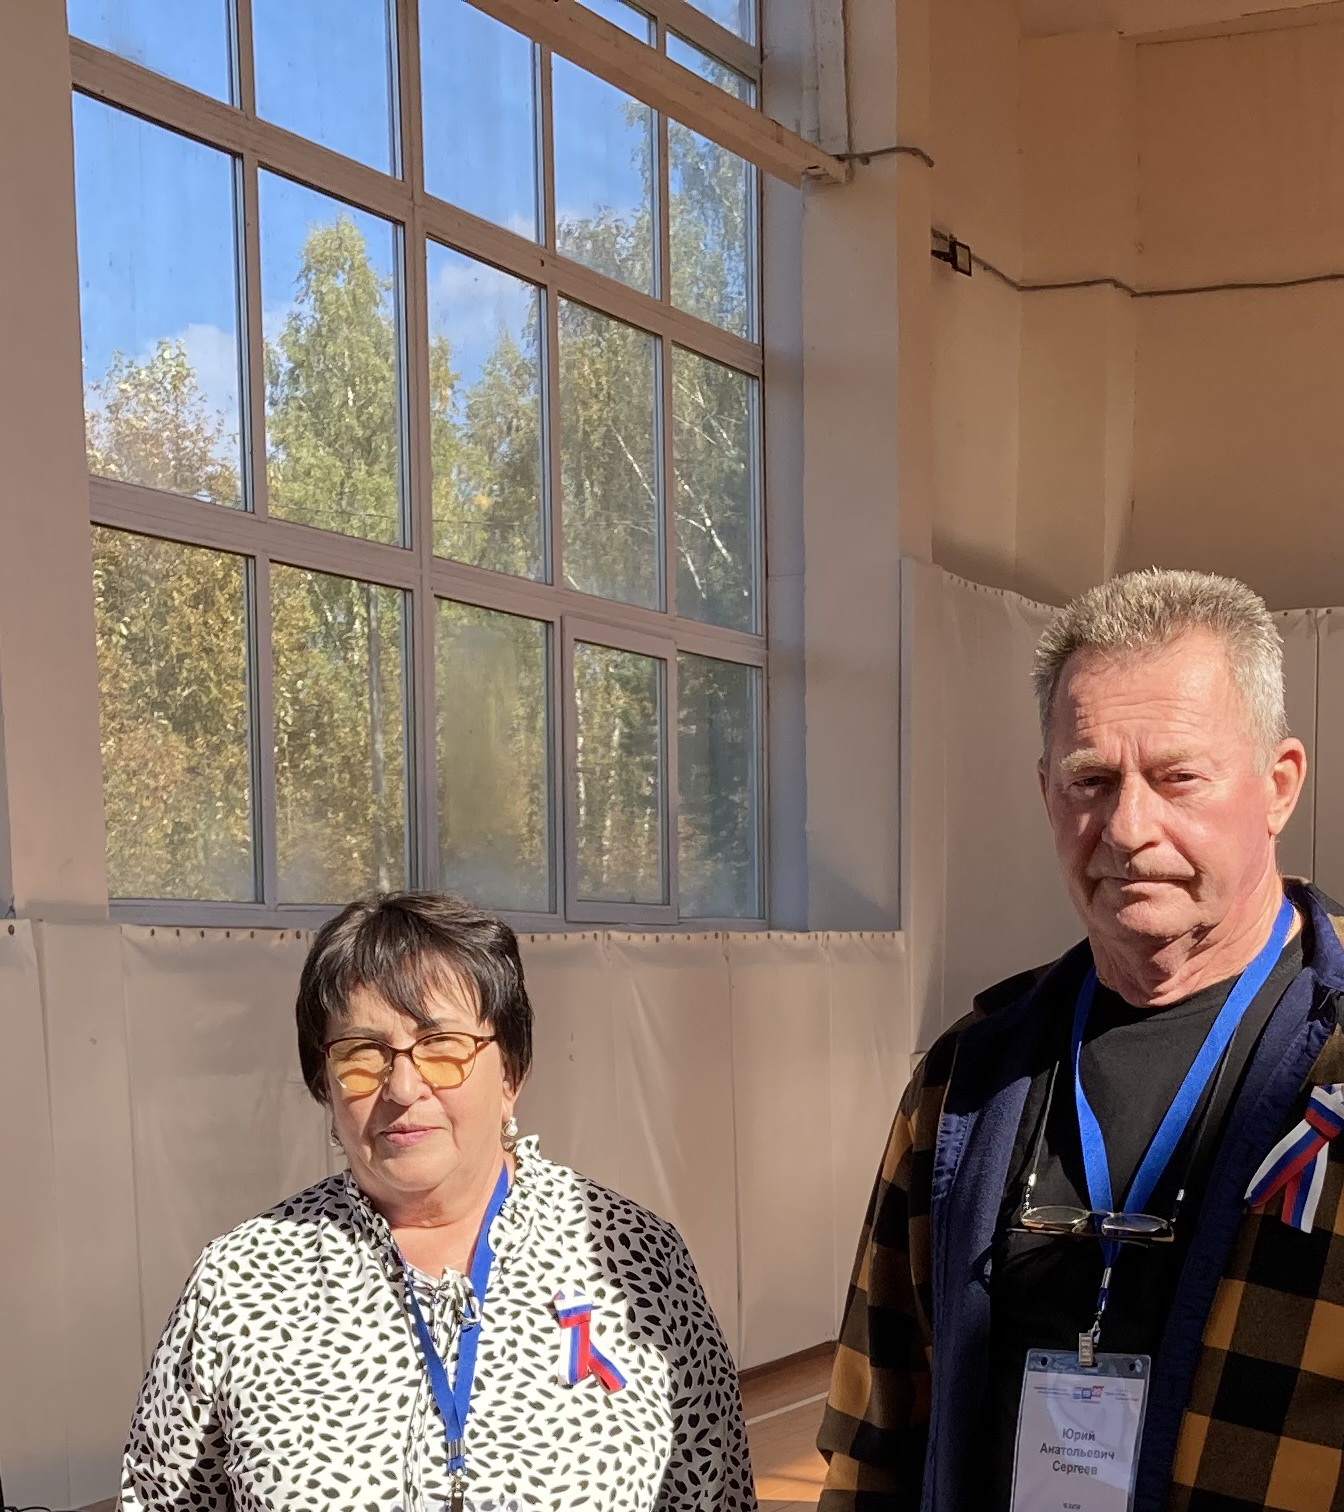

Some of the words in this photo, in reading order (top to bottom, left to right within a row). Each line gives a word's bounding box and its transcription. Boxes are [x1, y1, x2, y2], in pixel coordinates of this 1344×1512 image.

[1062, 1428, 1096, 1442] Юрий
[1039, 1443, 1115, 1460] Анатольевич
[1052, 1460, 1098, 1475] Сергеев
